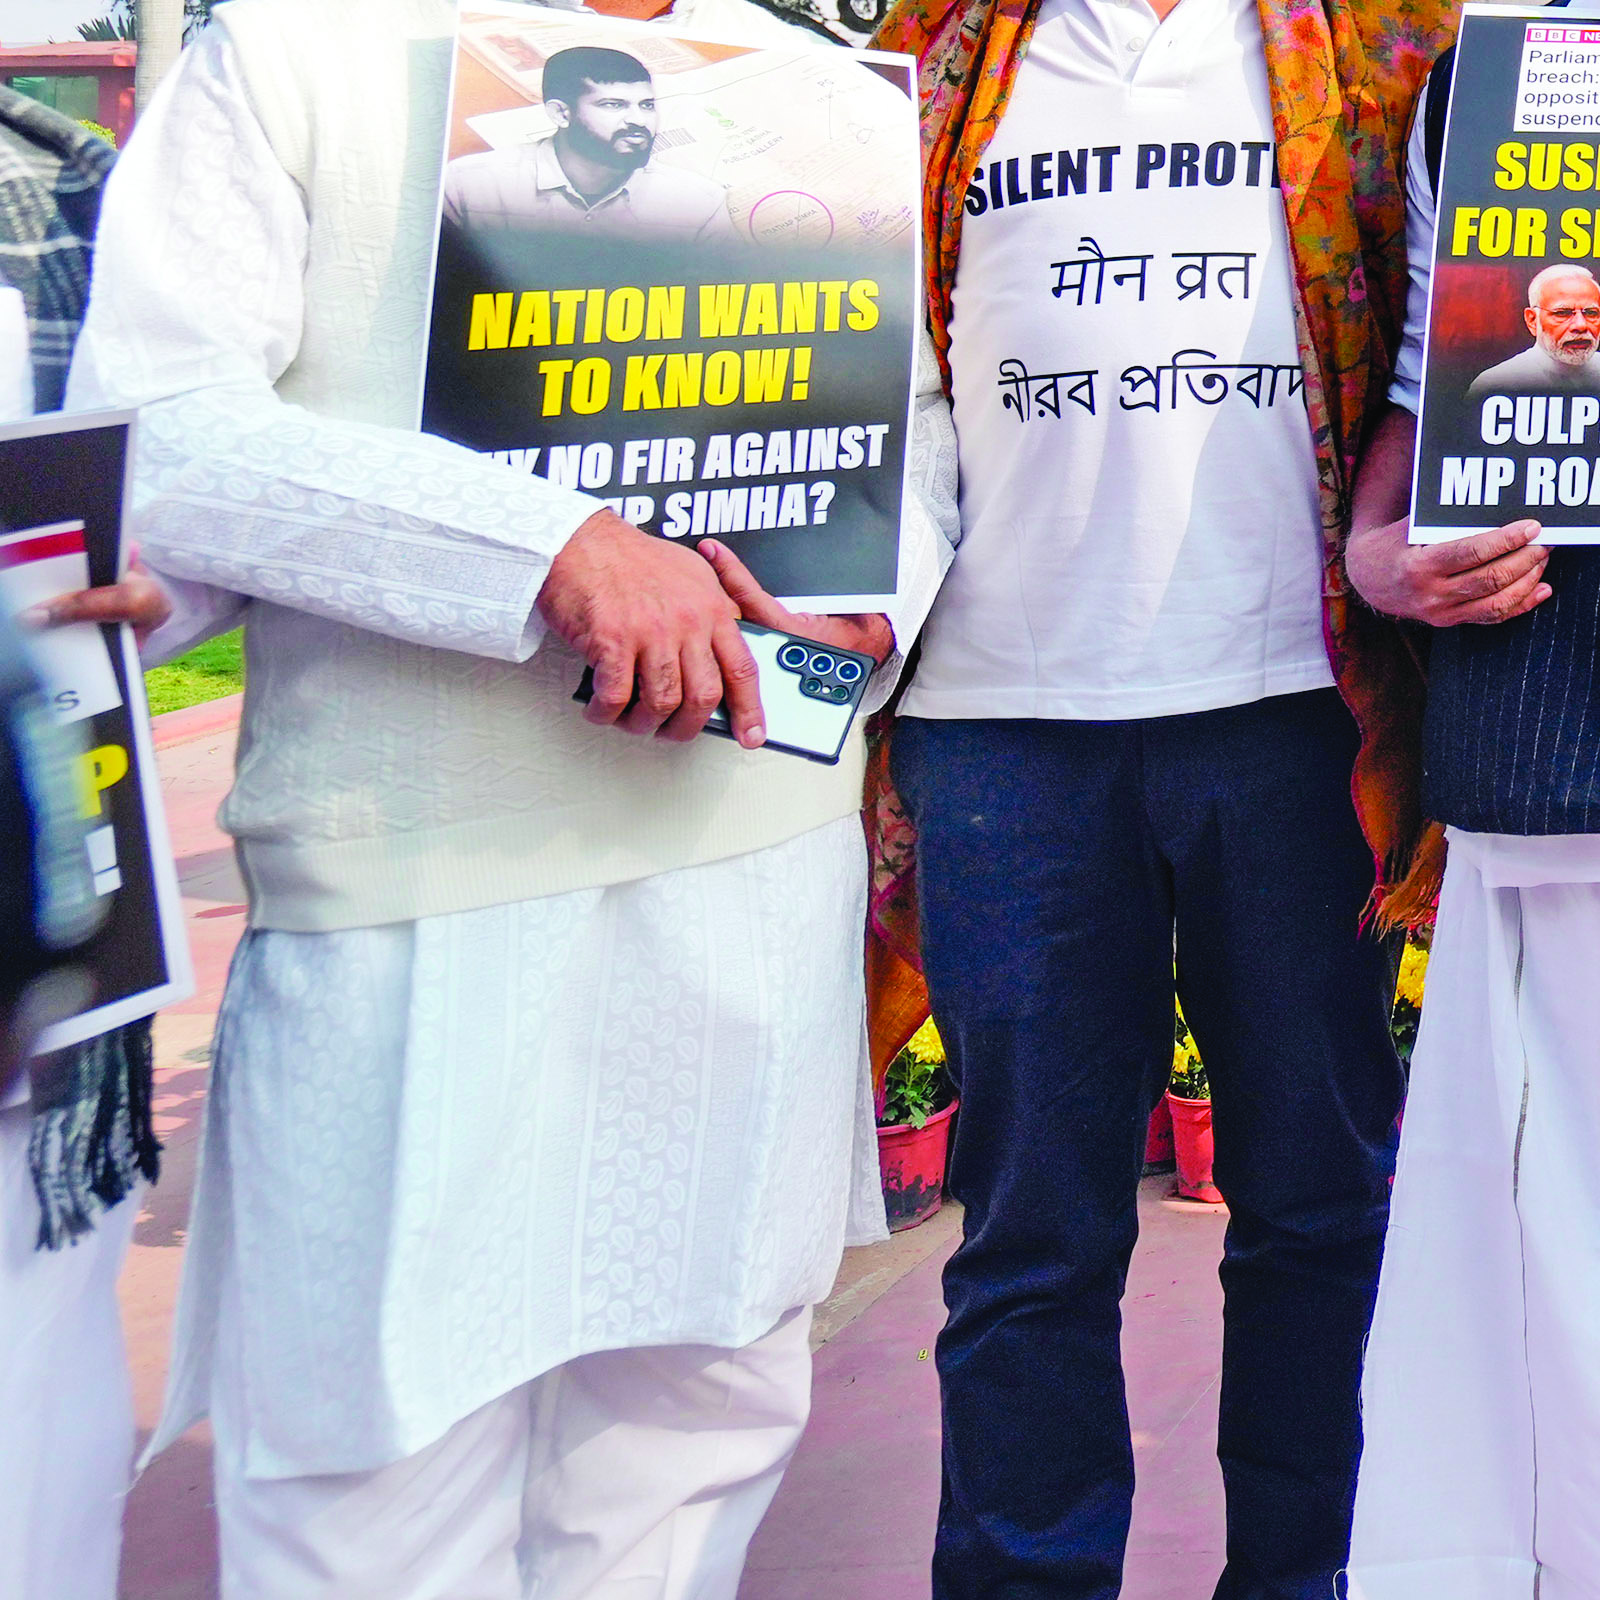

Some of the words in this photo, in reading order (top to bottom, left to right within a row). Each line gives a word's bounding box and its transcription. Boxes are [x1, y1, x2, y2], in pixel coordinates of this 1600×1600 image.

[1532, 30, 1580, 41] BBC
[1526, 69, 1599, 84] breach:
[964, 145, 1121, 217] SILENT
[1451, 206, 1548, 258] FOR
[1051, 236, 1154, 306] मौन
[1171, 252, 1257, 301] व्रत
[467, 286, 686, 351] NATION
[698, 279, 880, 338] WANTS
[538, 357, 612, 417] TO
[622, 346, 813, 412] KNOW!
[998, 358, 1099, 423] নীরব
[547, 442, 614, 490] NO
[621, 438, 696, 486] FIR
[701, 424, 890, 480] AGAINST
[1439, 457, 1515, 506] MP
[662, 482, 836, 538] SIMHA?
